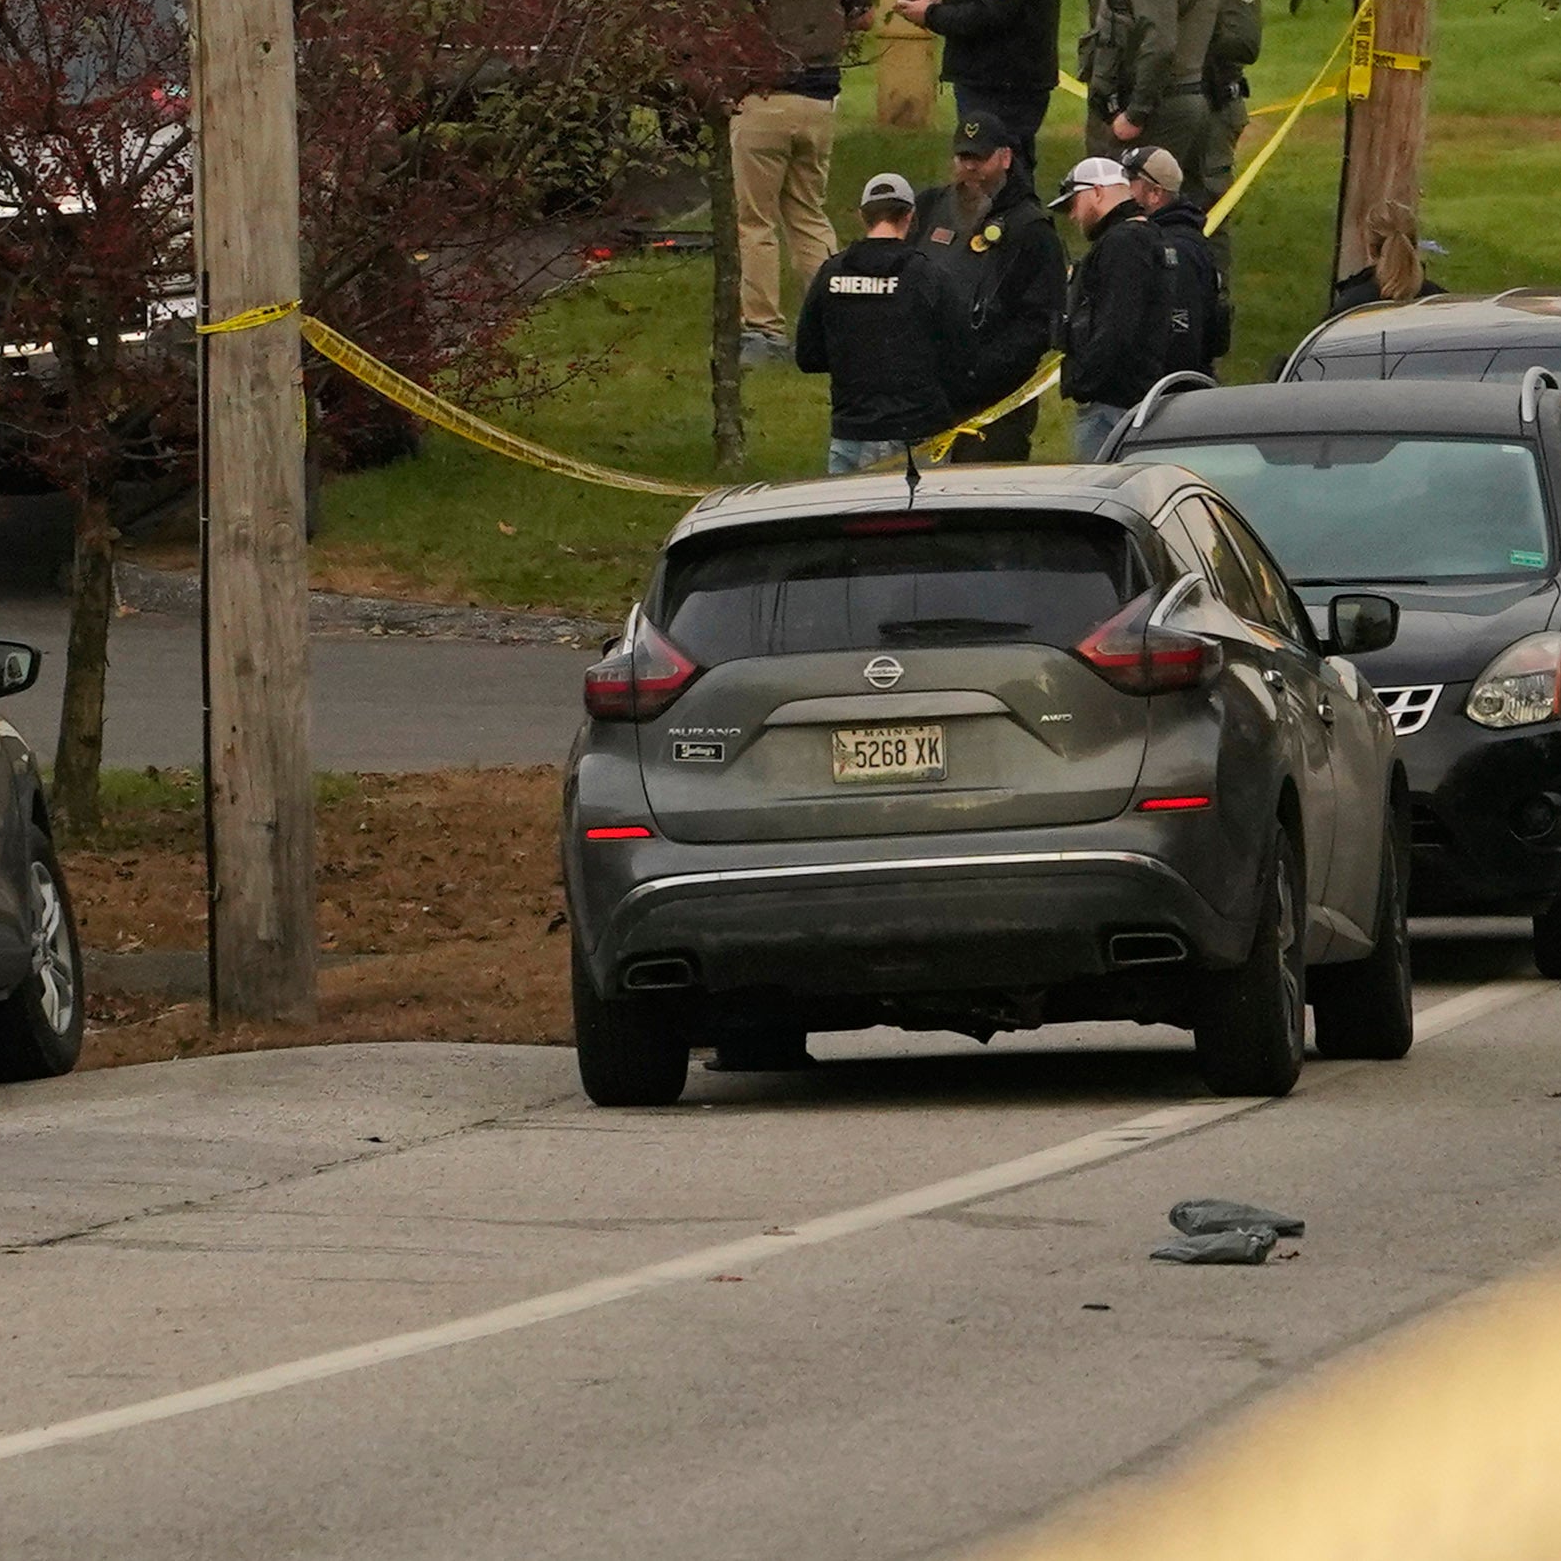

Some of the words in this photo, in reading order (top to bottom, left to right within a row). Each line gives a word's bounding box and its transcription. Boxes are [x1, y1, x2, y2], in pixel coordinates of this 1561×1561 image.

[828, 276, 899, 294] SHERIFF
[1039, 713, 1073, 723] AWD
[864, 728, 913, 737] MAINE
[855, 739, 907, 768] 5268
[915, 738, 940, 765] XK
